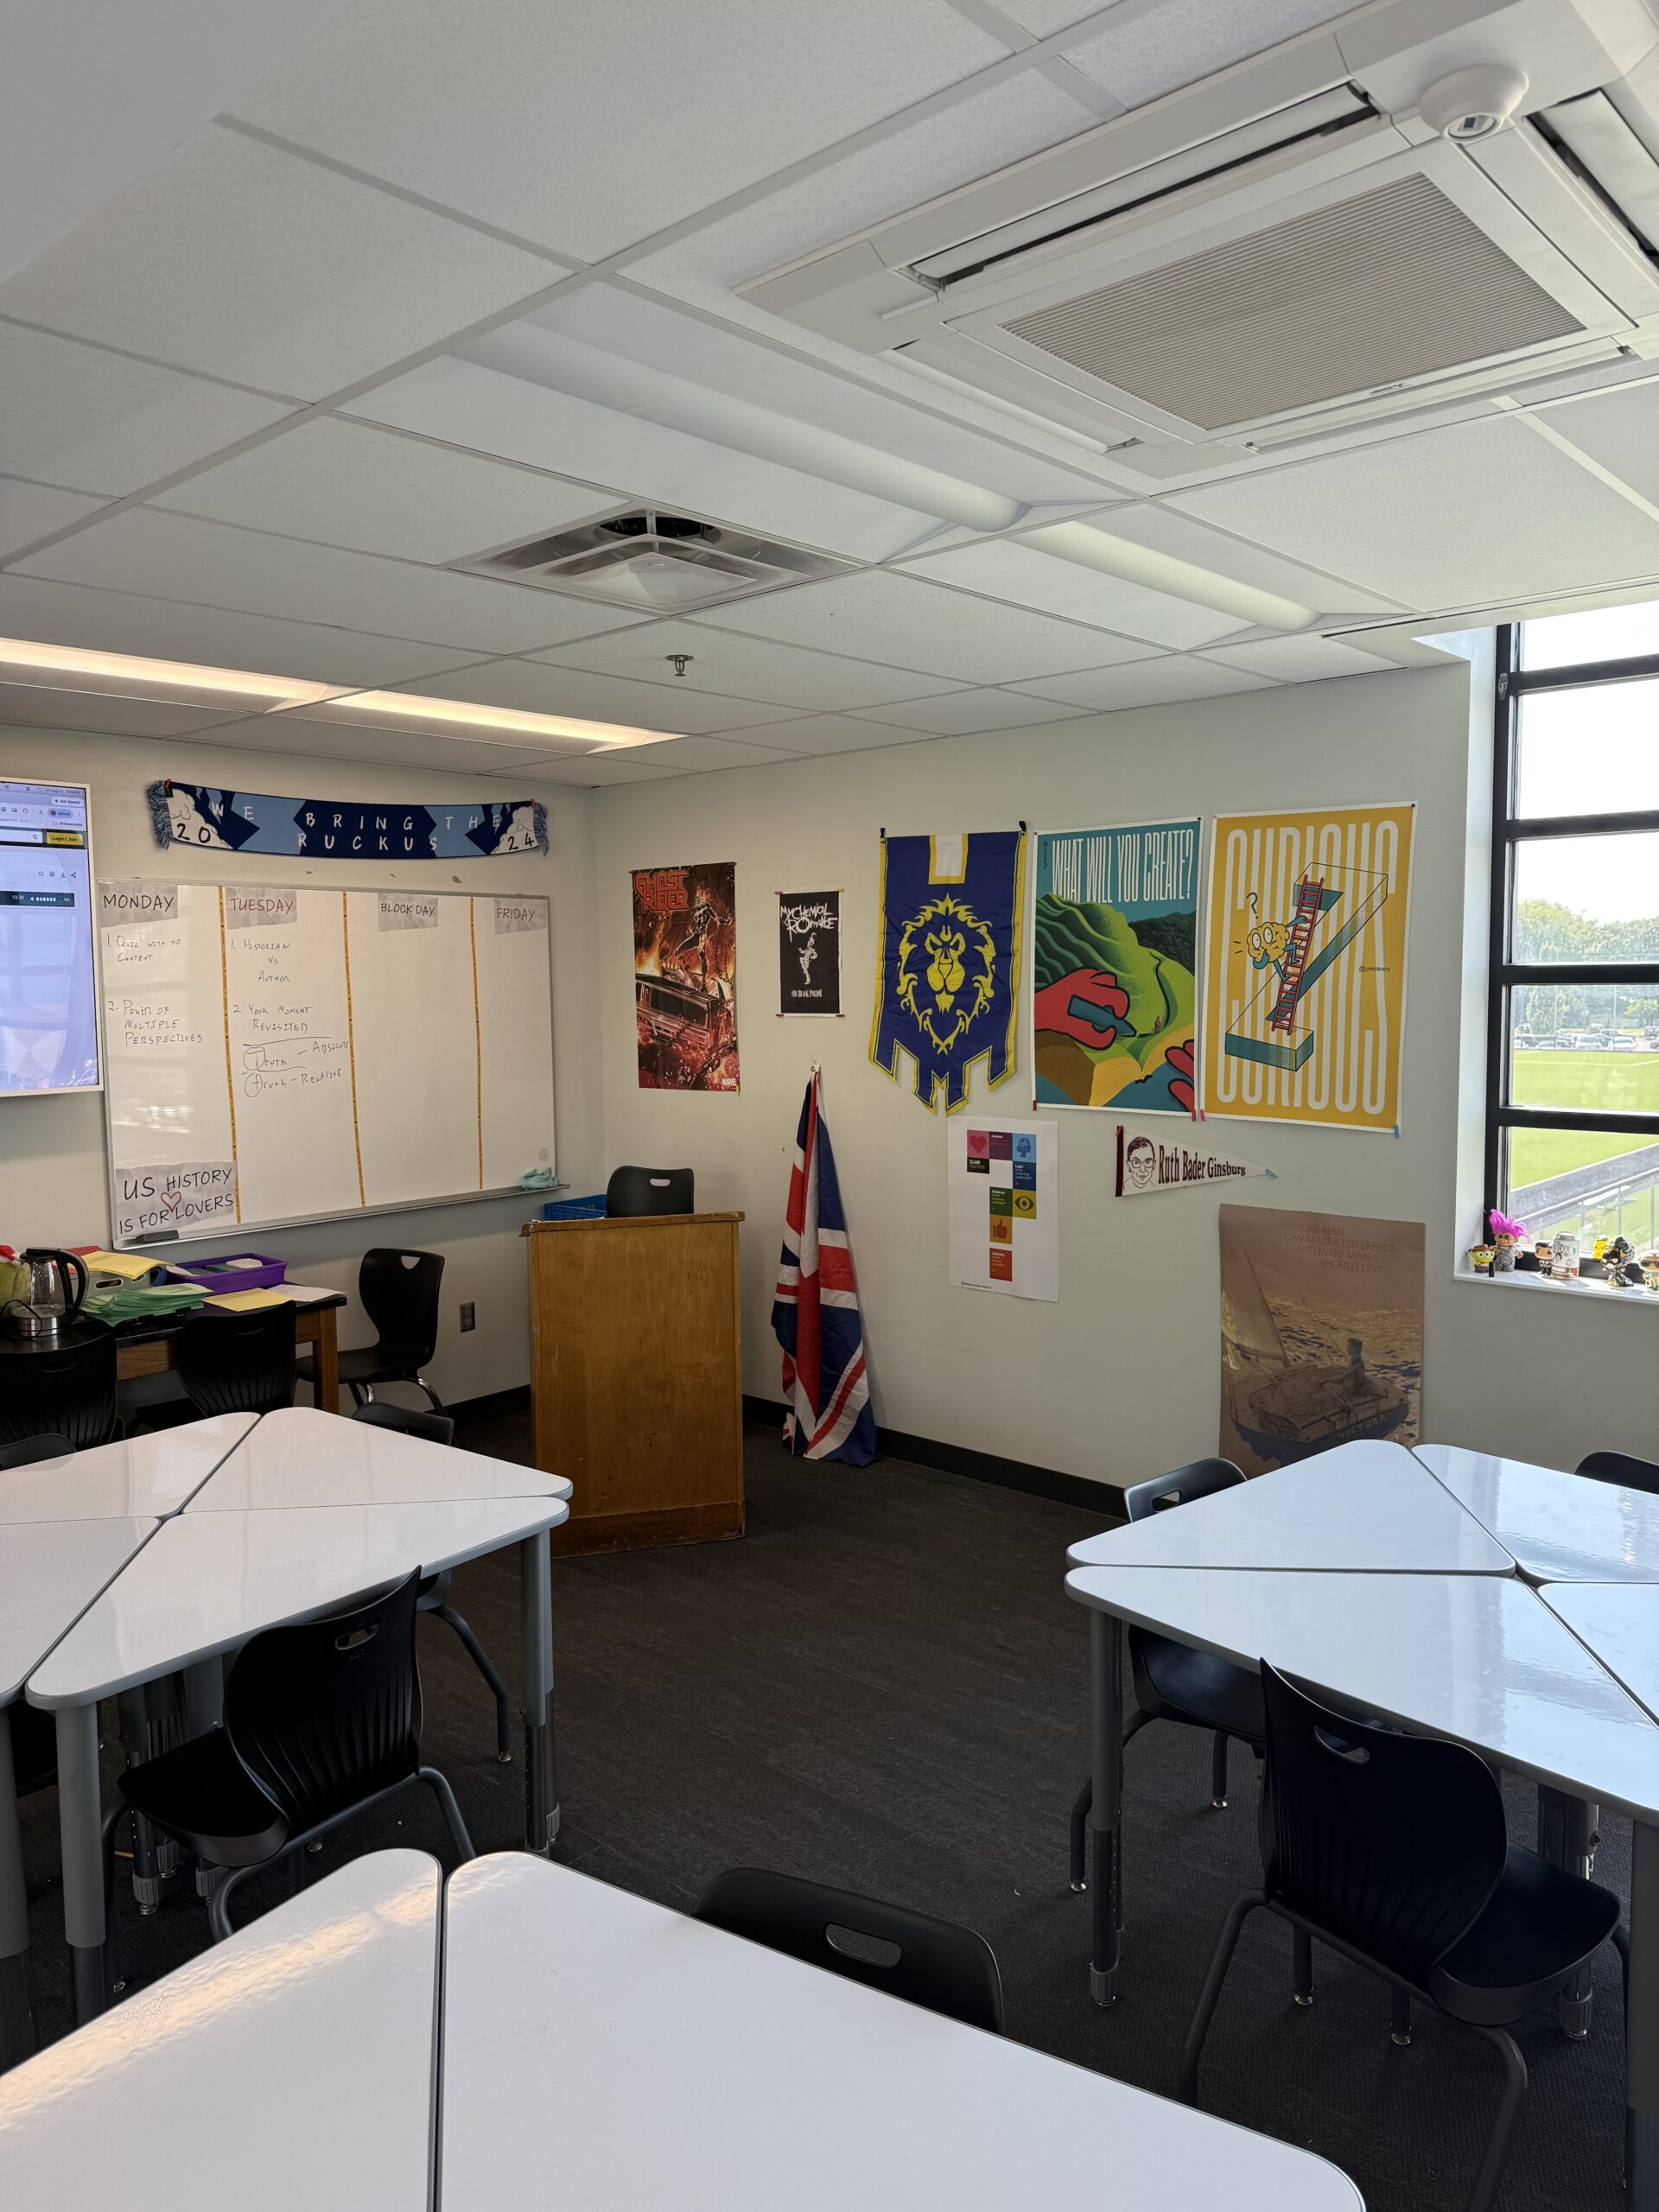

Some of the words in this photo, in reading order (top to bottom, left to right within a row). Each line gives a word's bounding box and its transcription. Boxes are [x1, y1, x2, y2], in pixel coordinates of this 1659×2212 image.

[212, 803, 254, 821] WE
[305, 812, 414, 830] BRING
[445, 815, 501, 830] THE
[176, 823, 212, 843] 20
[507, 833, 535, 850] 24
[296, 833, 438, 851] RUCKUS
[1052, 838, 1084, 904] WHAT
[1086, 836, 1113, 904] WILL
[1117, 833, 1141, 903] YOU
[1143, 829, 1194, 902] CREATE?
[635, 870, 690, 897] GHOST
[103, 893, 175, 912] MONDAY
[230, 897, 294, 914] TUESDAY
[642, 889, 690, 912] RIDER
[380, 903, 413, 914] BLOCK
[416, 906, 435, 917] DAY
[496, 907, 535, 923] FRIDAY
[106, 933, 113, 948] 1.
[231, 938, 236, 950] 1.
[244, 938, 291, 950] HISTORIAN
[257, 969, 291, 982] AUTHOR
[107, 1000, 118, 1012] 2.
[276, 1004, 312, 1014] MOMENT
[124, 1019, 181, 1030] MULTIPLE
[251, 1018, 308, 1034] REVISITED
[124, 1031, 203, 1047] PERSPECTIVES
[1158, 1144, 1180, 1185] Ruth
[1182, 1150, 1206, 1181] Bader
[1207, 1157, 1246, 1179] Ginsburg
[124, 1176, 156, 1200] US
[166, 1167, 232, 1192] HISTORY
[119, 1218, 134, 1235] IS
[139, 1210, 170, 1229] FOR
[175, 1193, 234, 1220] LOVERS
[1284, 1232, 1304, 1243] CAN
[1306, 1235, 1332, 1246] MAKE
[1342, 1238, 1397, 1253] DIFFERENCE
[1294, 1245, 1317, 1255] AND
[1318, 1248, 1344, 1258] EVERY
[1346, 1251, 1370, 1261] MAN
[1320, 1258, 1359, 1271] SHOULD
[1337, 1414, 1387, 1439] VICTURA
